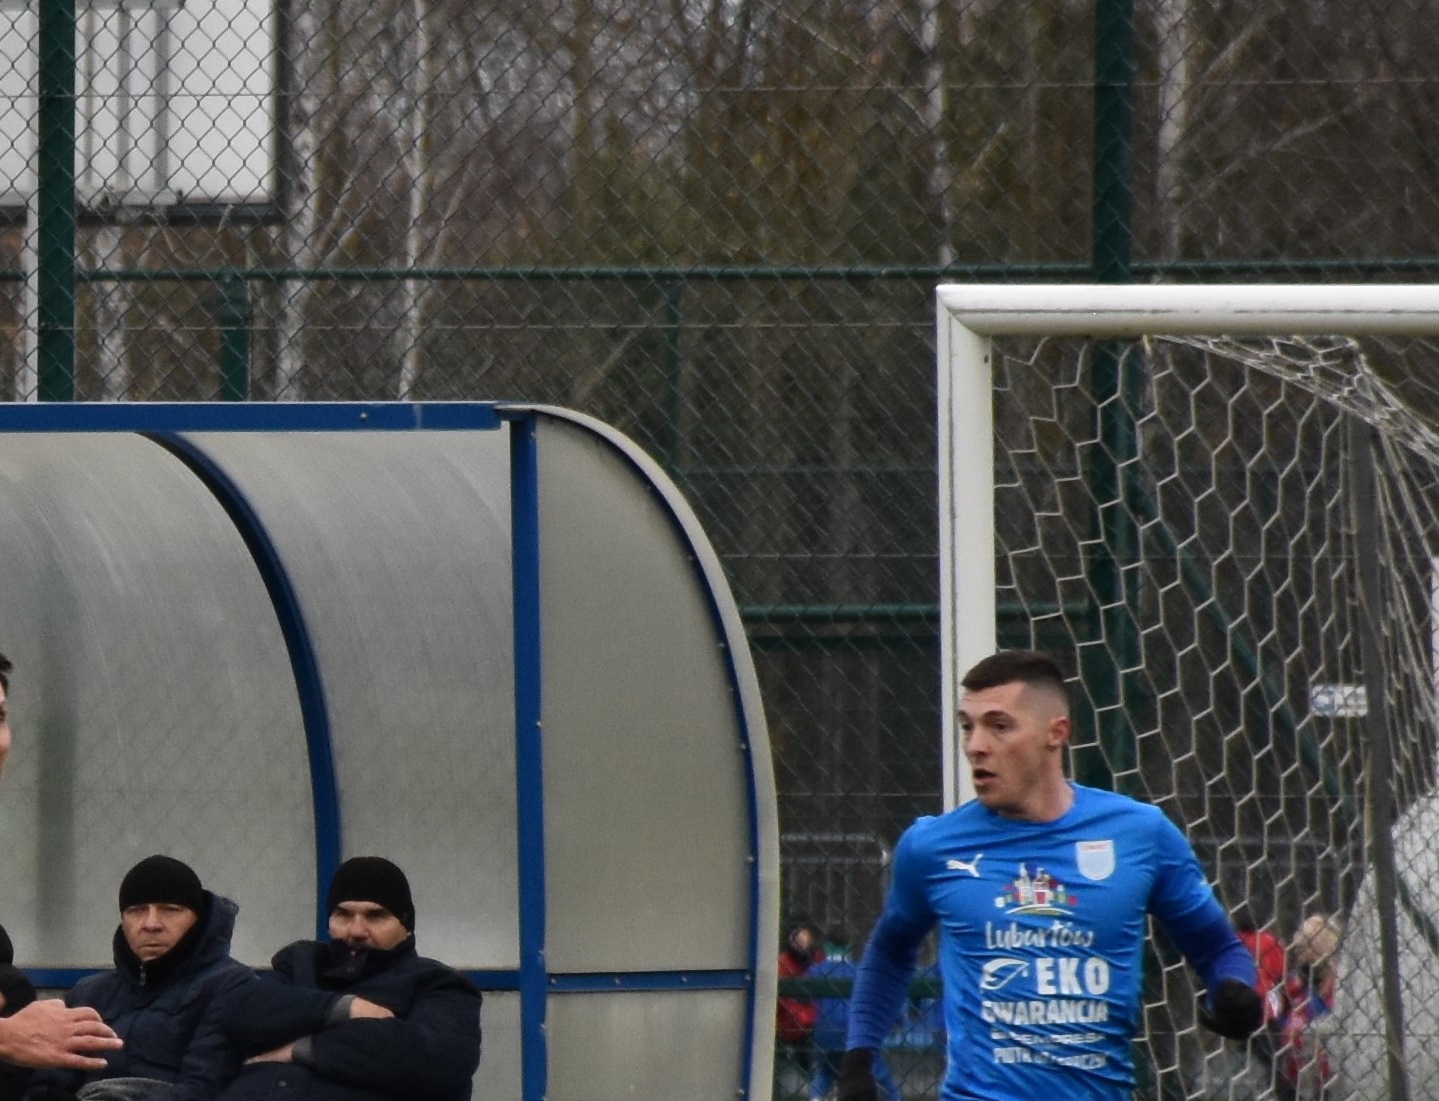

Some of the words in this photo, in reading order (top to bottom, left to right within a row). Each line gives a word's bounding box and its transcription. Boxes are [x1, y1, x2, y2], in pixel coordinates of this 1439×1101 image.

[985, 920, 1094, 949] Lubartów
[1036, 957, 1110, 995] EKO
[982, 1000, 1108, 1025] GWARANCJA
